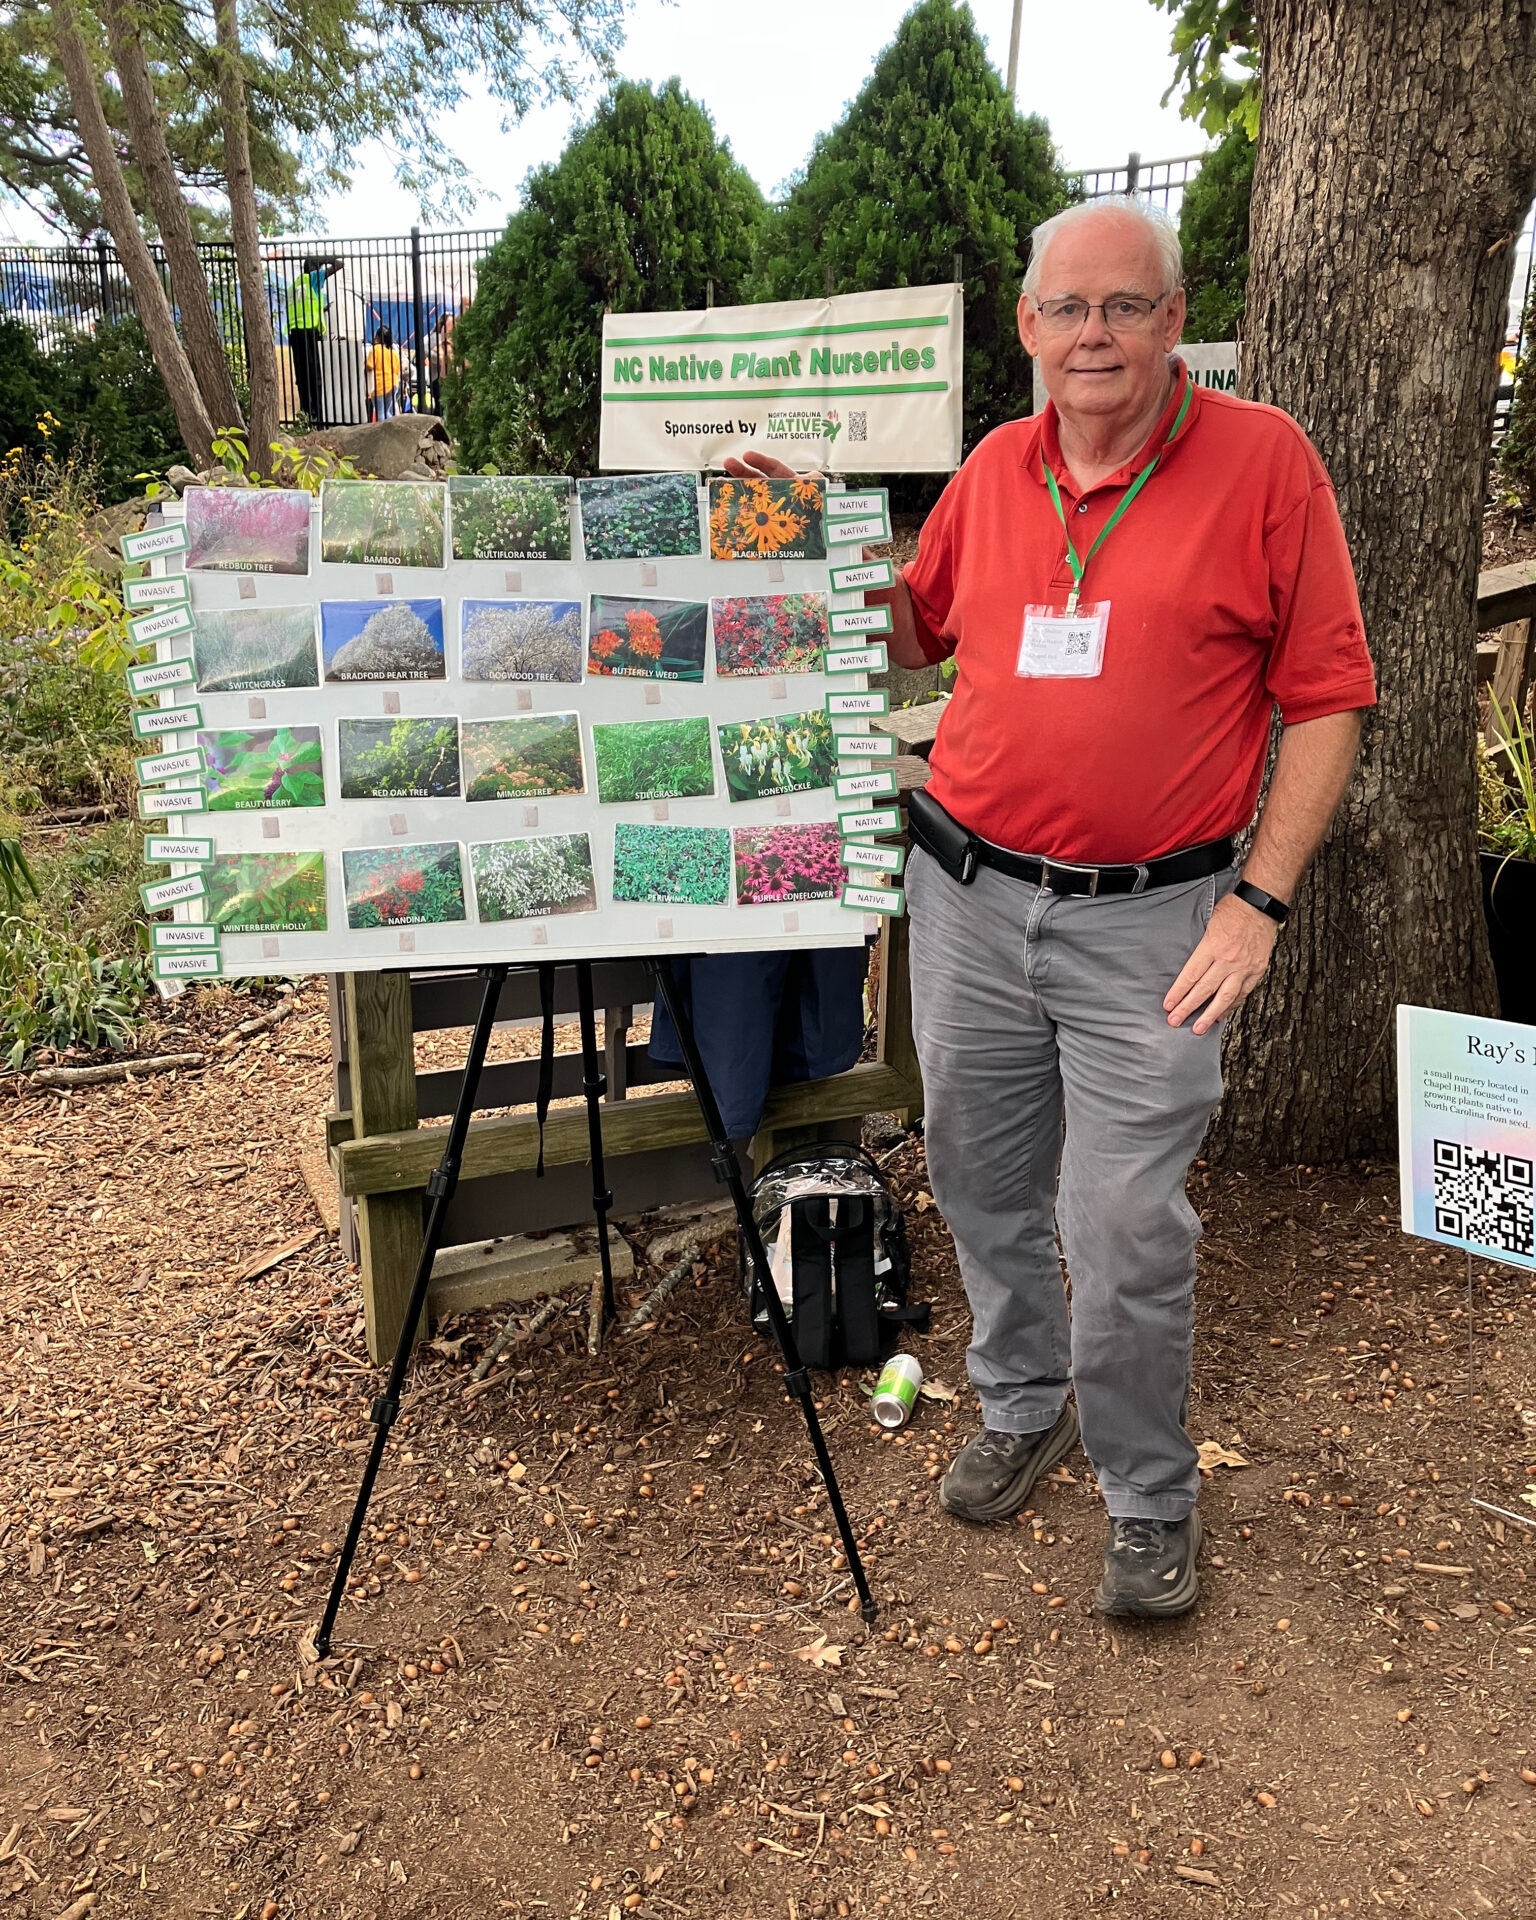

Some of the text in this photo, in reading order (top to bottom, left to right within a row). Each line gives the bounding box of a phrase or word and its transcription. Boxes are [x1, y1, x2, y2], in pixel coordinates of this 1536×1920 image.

[614, 342, 935, 382] NC Native Plant Nurseries
[665, 420, 757, 436] Sponsored by
[767, 418, 821, 432] NATIVE
[839, 500, 868, 510] NATIVE
[839, 524, 869, 535] NATIVE
[136, 535, 175, 551] INVASIVE
[364, 555, 401, 565] BAMBOO
[475, 550, 547, 559] MULTIFLORA ROSE
[778, 550, 805, 559] SUSAN
[218, 562, 252, 571] REDBUD
[845, 570, 874, 582] NATIVE
[138, 585, 176, 596] INVASIVE
[142, 615, 180, 632] INVASIVE
[844, 615, 873, 625] NATIVE
[840, 654, 869, 665] NATIVE
[142, 668, 181, 683] INVASIVE
[341, 670, 428, 680] BRADFORD PEAR TREE
[489, 671, 555, 681] DOGWOOD TREE
[611, 667, 678, 679] BUTTERFLY WEED
[228, 679, 286, 689] SWITCHGRASS
[842, 699, 871, 708] NATIVE
[148, 713, 188, 726] INVASIVE
[849, 741, 878, 751] NATIVE
[151, 758, 190, 773] INVASIVE
[757, 782, 811, 796] HONEYSUCKLE
[850, 779, 879, 790] NATIVE
[372, 788, 428, 797] RED OAK TREE
[496, 787, 551, 798] MIMOSA TREE
[635, 789, 678, 800] STILTGRASS
[153, 796, 193, 807] INVASIVE
[235, 798, 292, 809] BEAUTYBERRY
[855, 816, 883, 827] NATIVE
[160, 844, 200, 854] INVASIVE
[855, 851, 884, 862] NATIVE
[156, 882, 194, 900] INVASIVE
[753, 890, 834, 903] PURPLE CONEFLOWER
[647, 893, 693, 903] PERIWINKLE
[857, 894, 886, 904] NATIVE
[524, 907, 551, 917] PRIVET
[387, 916, 426, 925] NANDINA
[223, 922, 306, 932] WINTERBERRY HOLLY
[165, 931, 205, 941] INVASIVE
[168, 958, 207, 969] INVASIVE
[1467, 1035, 1525, 1065] Ray's
[1430, 1070, 1452, 1079] small
[1454, 1075, 1485, 1087] nursery
[1488, 1080, 1518, 1093] located
[1520, 1086, 1529, 1095] in
[1424, 1079, 1452, 1093] Chapel
[1453, 1084, 1472, 1096] Hill,
[1474, 1087, 1505, 1102] focused
[1424, 1091, 1522, 1116] growing plants native to
[1424, 1100, 1530, 1129] North Carolina from seed.
